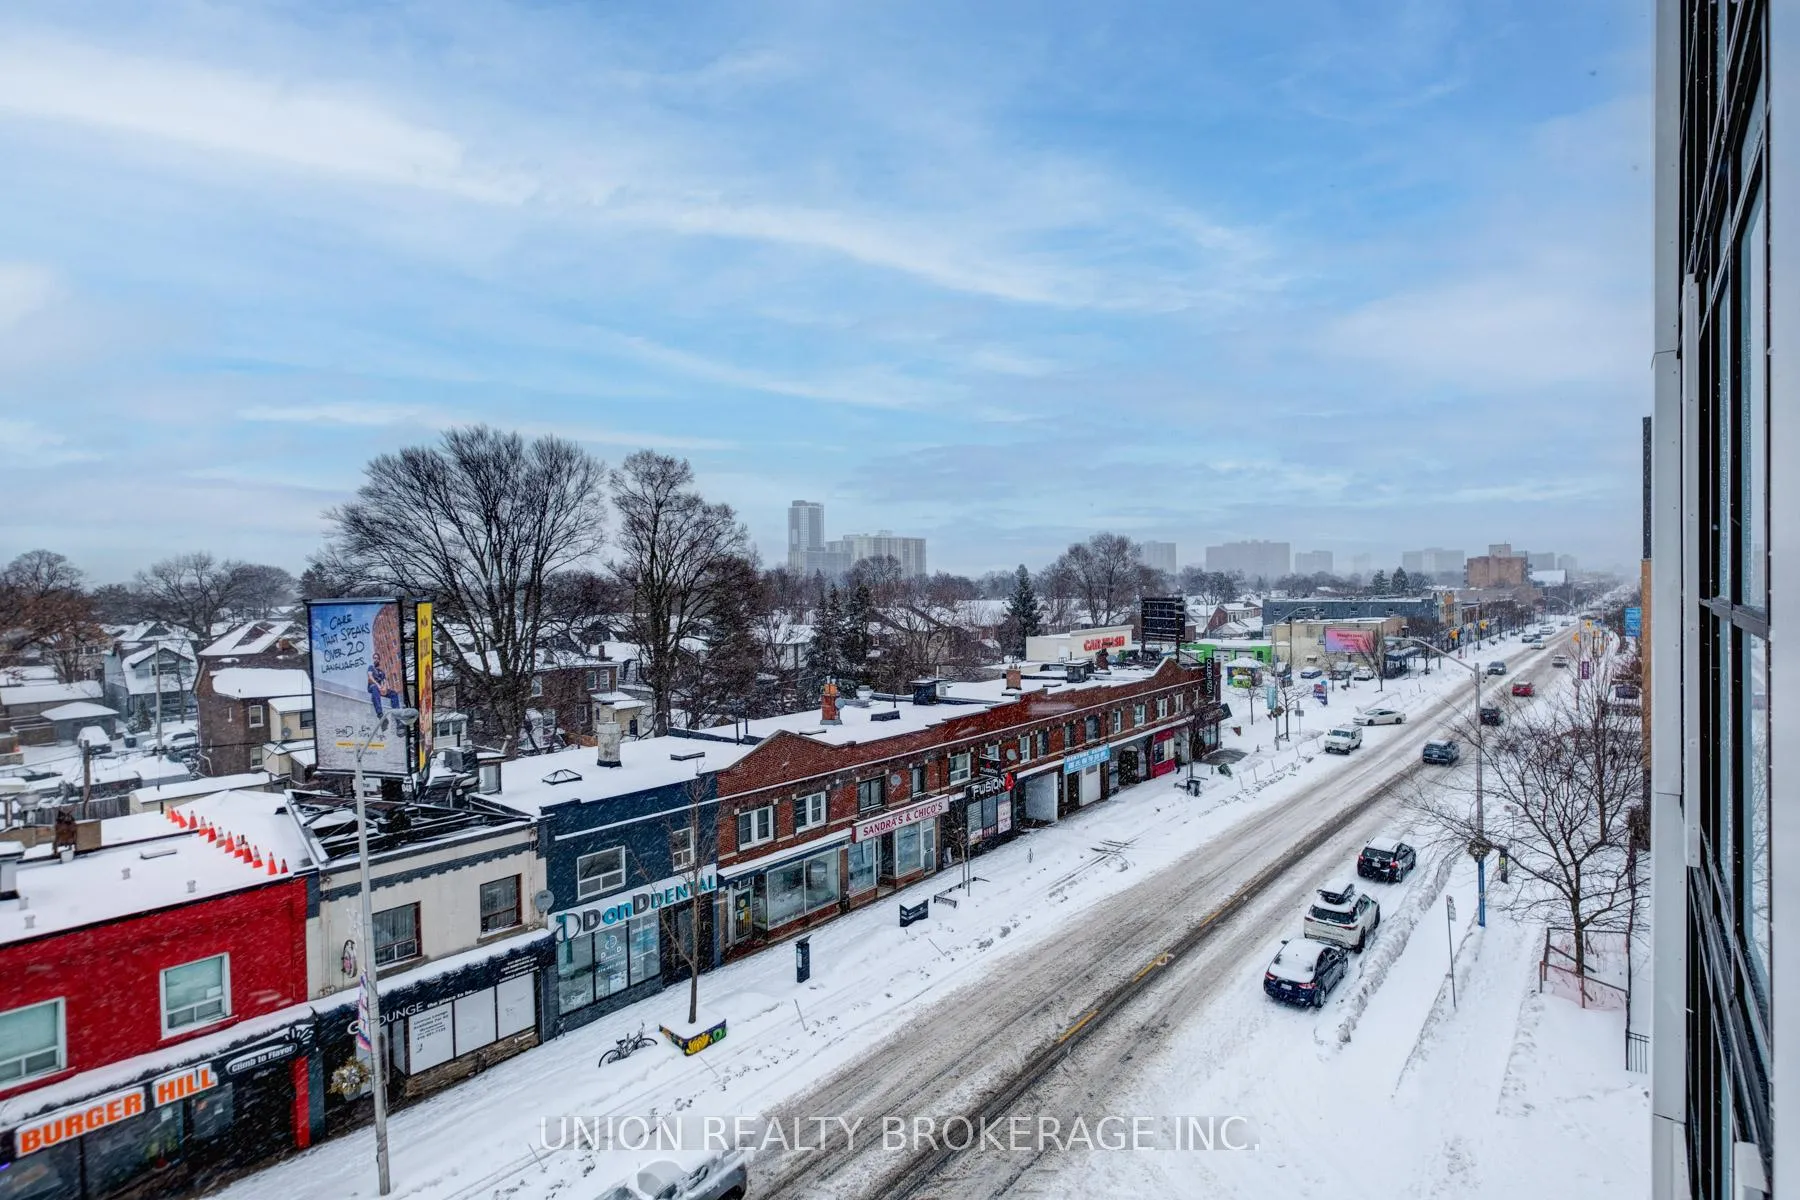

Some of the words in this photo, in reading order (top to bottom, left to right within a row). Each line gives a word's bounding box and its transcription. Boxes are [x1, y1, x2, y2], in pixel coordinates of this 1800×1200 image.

[330, 614, 352, 630] CARE
[321, 632, 338, 648] THAT
[340, 623, 370, 641] SPEAKS
[324, 648, 345, 662] OVER
[346, 641, 365, 657] 20
[971, 774, 1005, 798] FUSION
[863, 815, 903, 837] SANDRA'S
[905, 813, 911, 822] &
[913, 802, 943, 819] CHICO'S
[650, 875, 717, 910] DENTAL
[231, 1058, 256, 1072] Climb
[257, 1054, 267, 1064] to
[268, 1045, 294, 1060] Flavor
[21, 1092, 143, 1153] BURGER
[158, 1068, 216, 1104] HILL
